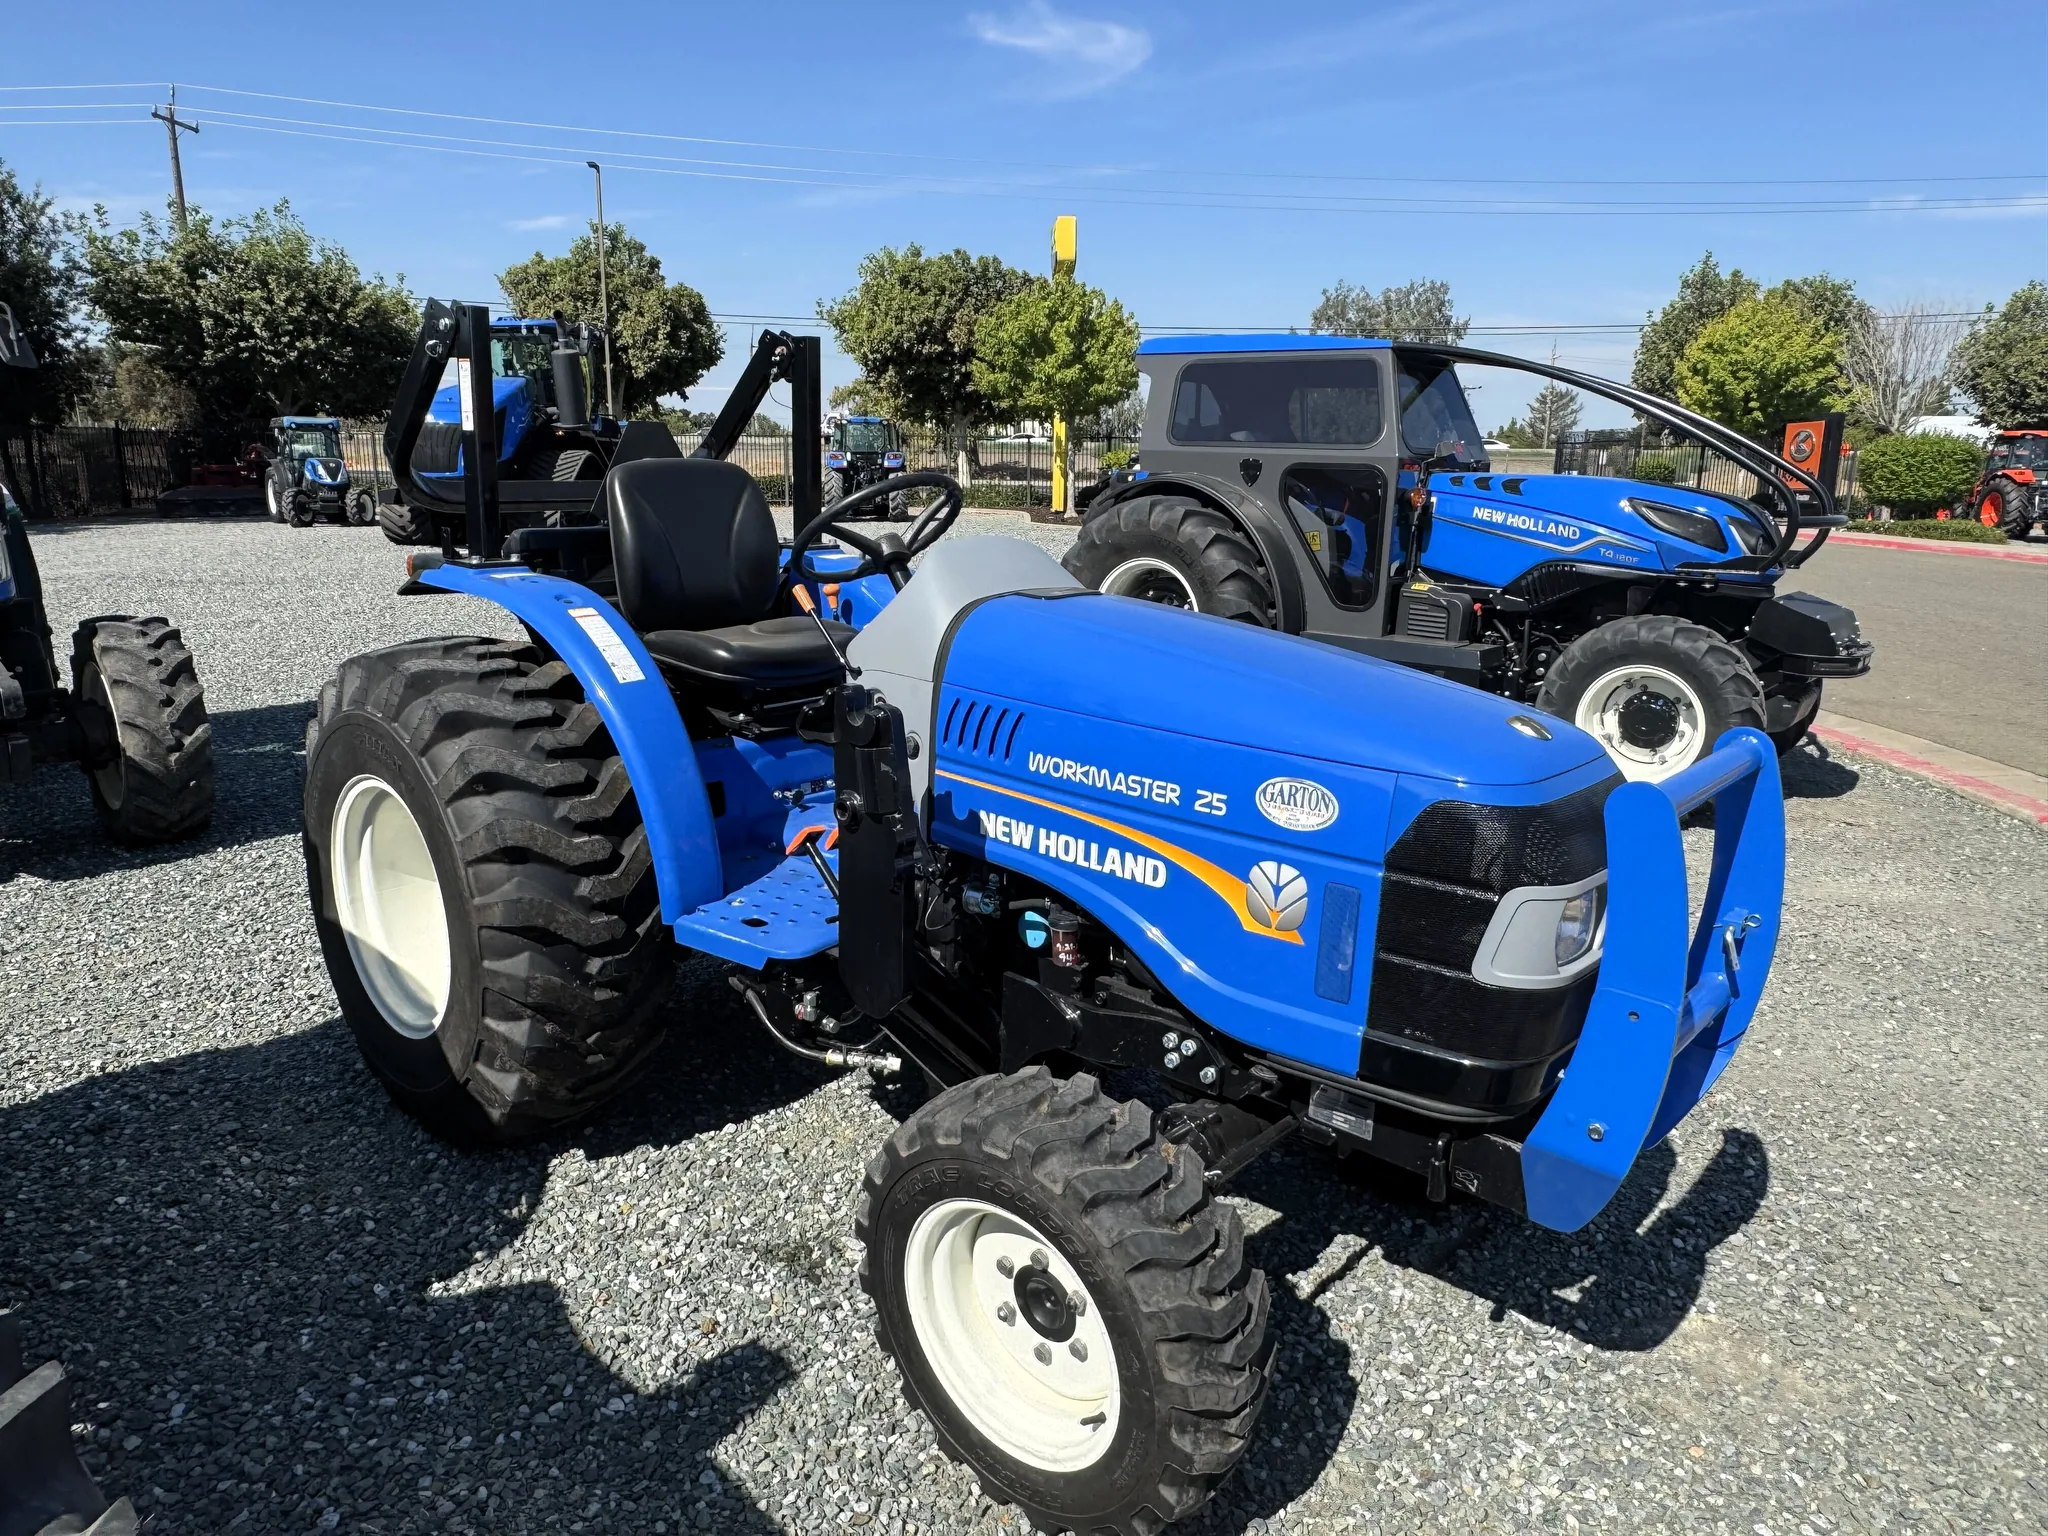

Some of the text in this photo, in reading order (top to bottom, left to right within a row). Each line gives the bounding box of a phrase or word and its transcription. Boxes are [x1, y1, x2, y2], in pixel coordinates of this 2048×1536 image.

[1472, 507, 1580, 540] NEW HOLLAND
[1029, 751, 1181, 806] WORKMASTER
[1194, 789, 1228, 816] 25
[1262, 783, 1331, 814] GARTON
[979, 809, 1167, 889] NEW HOLLAND
